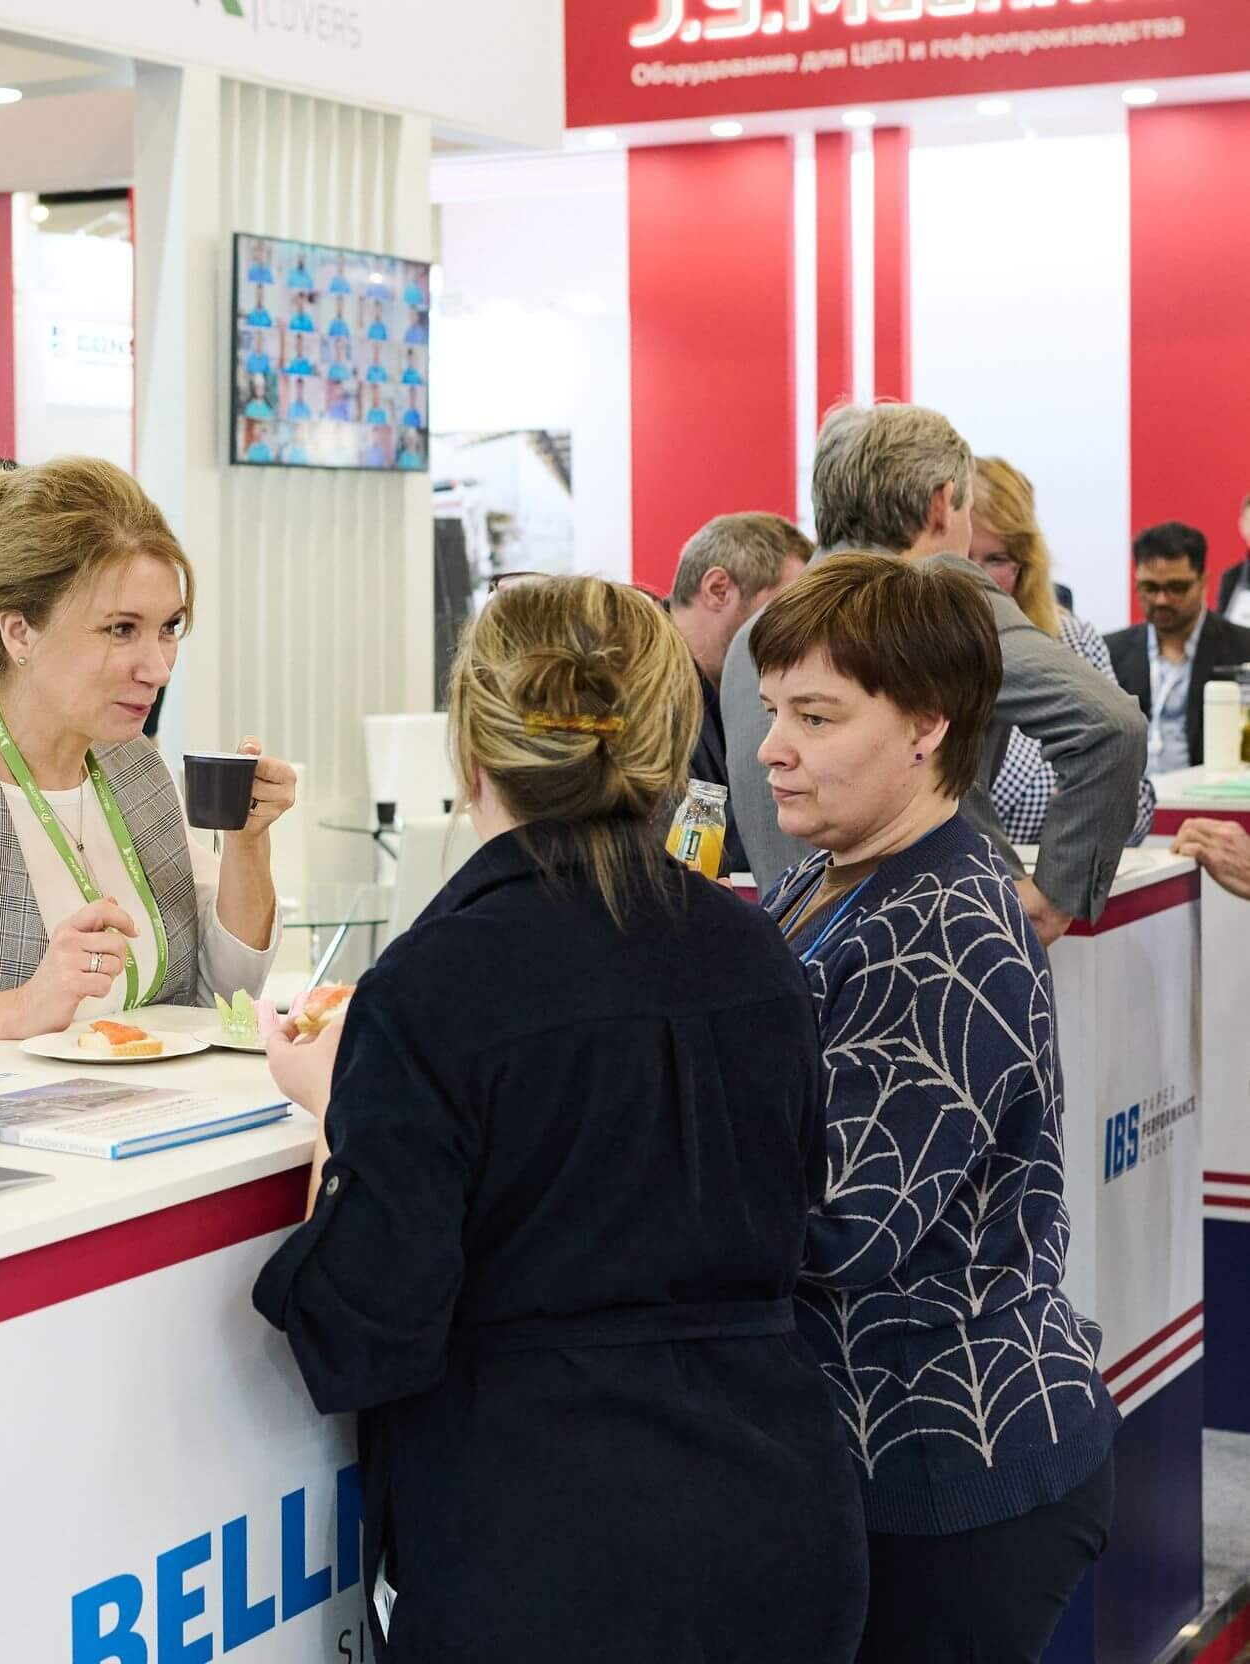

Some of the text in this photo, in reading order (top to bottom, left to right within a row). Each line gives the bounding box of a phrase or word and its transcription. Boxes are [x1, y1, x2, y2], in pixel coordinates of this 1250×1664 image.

[263, 0, 360, 49] COVERS
[631, 16, 1185, 87] Оборудование для ЦБП и гофропроизводства
[1141, 1095, 1196, 1137] PERFORMANCE
[1142, 1085, 1175, 1113] PAPER
[1104, 1103, 1140, 1184] IBS
[1140, 1127, 1175, 1163] GROUP
[71, 1461, 364, 1664] BELL
